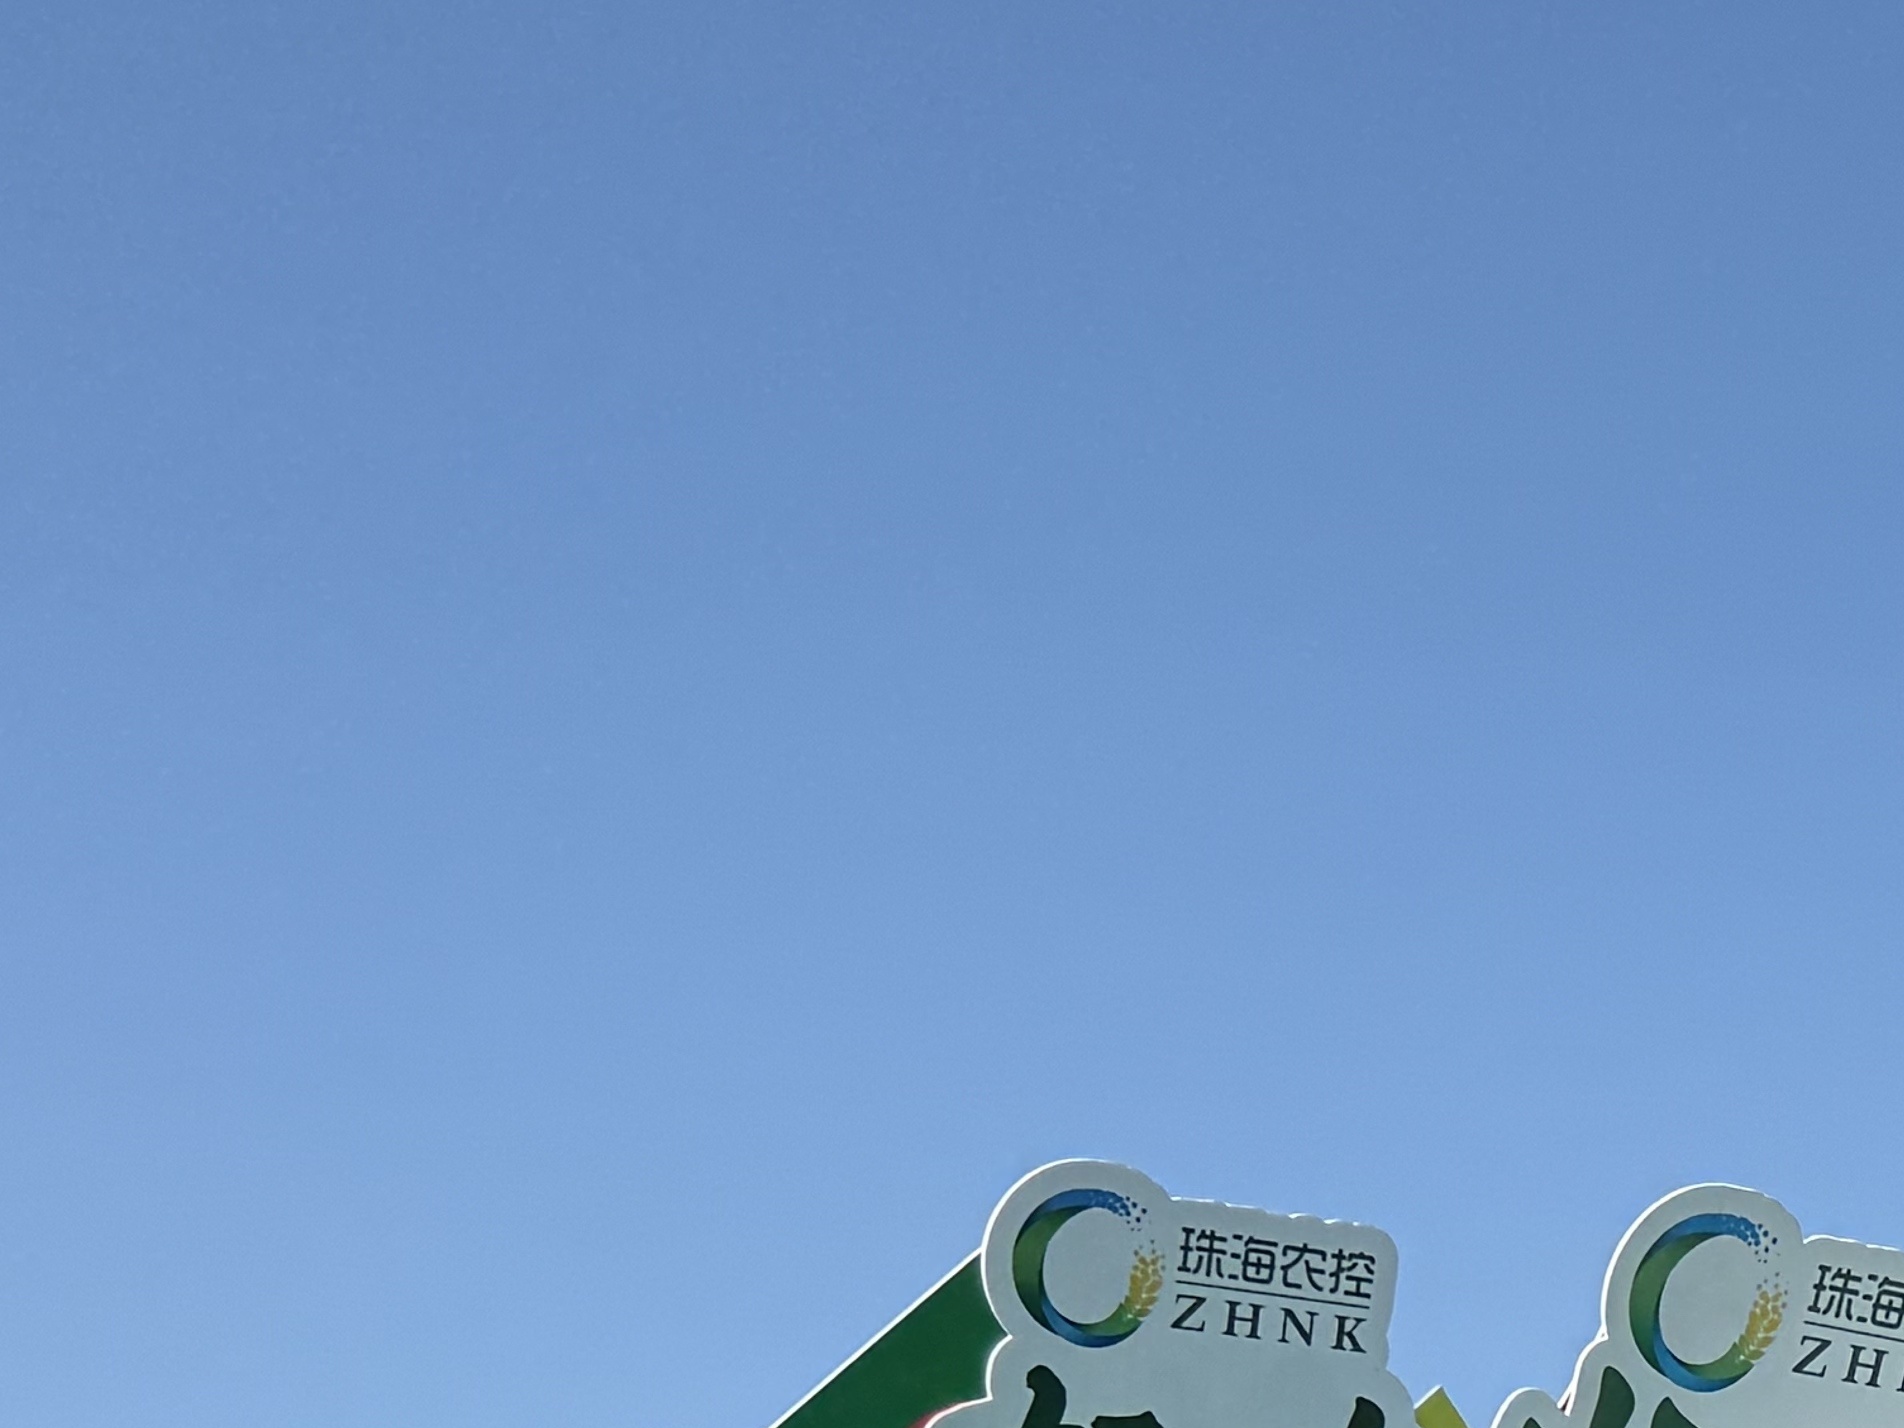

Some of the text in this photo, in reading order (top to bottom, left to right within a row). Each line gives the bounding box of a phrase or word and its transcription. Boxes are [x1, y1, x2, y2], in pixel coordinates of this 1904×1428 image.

[1176, 1226, 1376, 1299] 珠海农控
[1170, 1294, 1368, 1354] ZHNK
